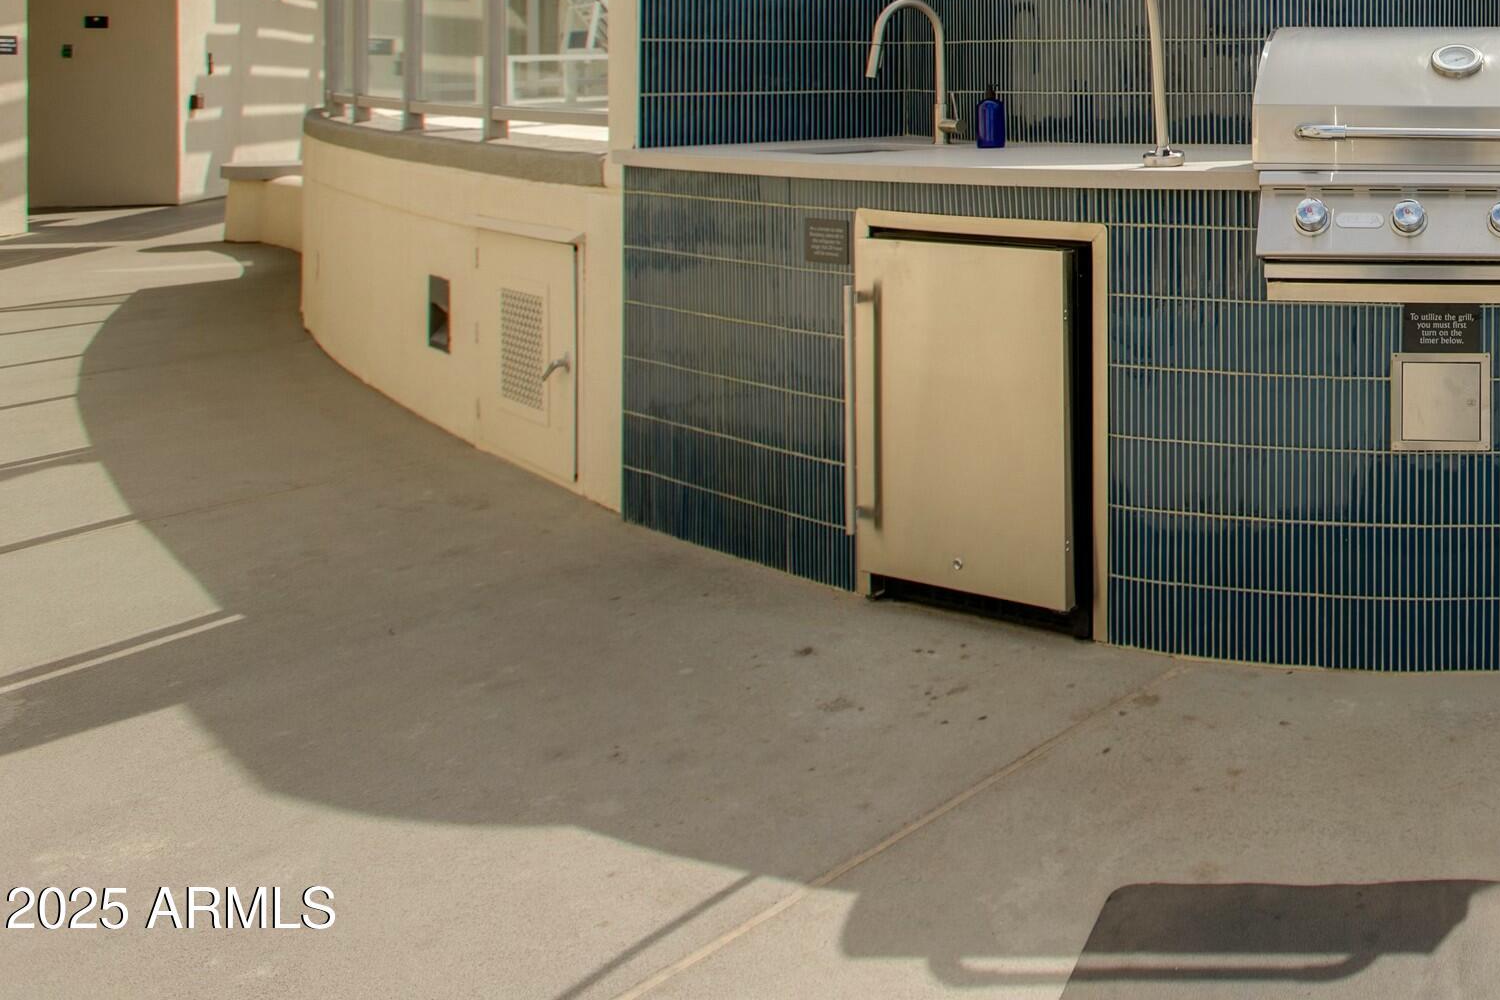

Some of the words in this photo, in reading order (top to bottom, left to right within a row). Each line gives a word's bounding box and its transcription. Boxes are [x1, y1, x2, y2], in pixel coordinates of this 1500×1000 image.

[1410, 312, 1419, 321] To
[1421, 313, 1443, 321] utilize
[1444, 313, 1456, 321] the
[1458, 313, 1475, 322] grill,
[1417, 322, 1431, 330] you
[1452, 321, 1467, 329] first
[1419, 336, 1439, 344] timer
[1440, 336, 1464, 344] below.
